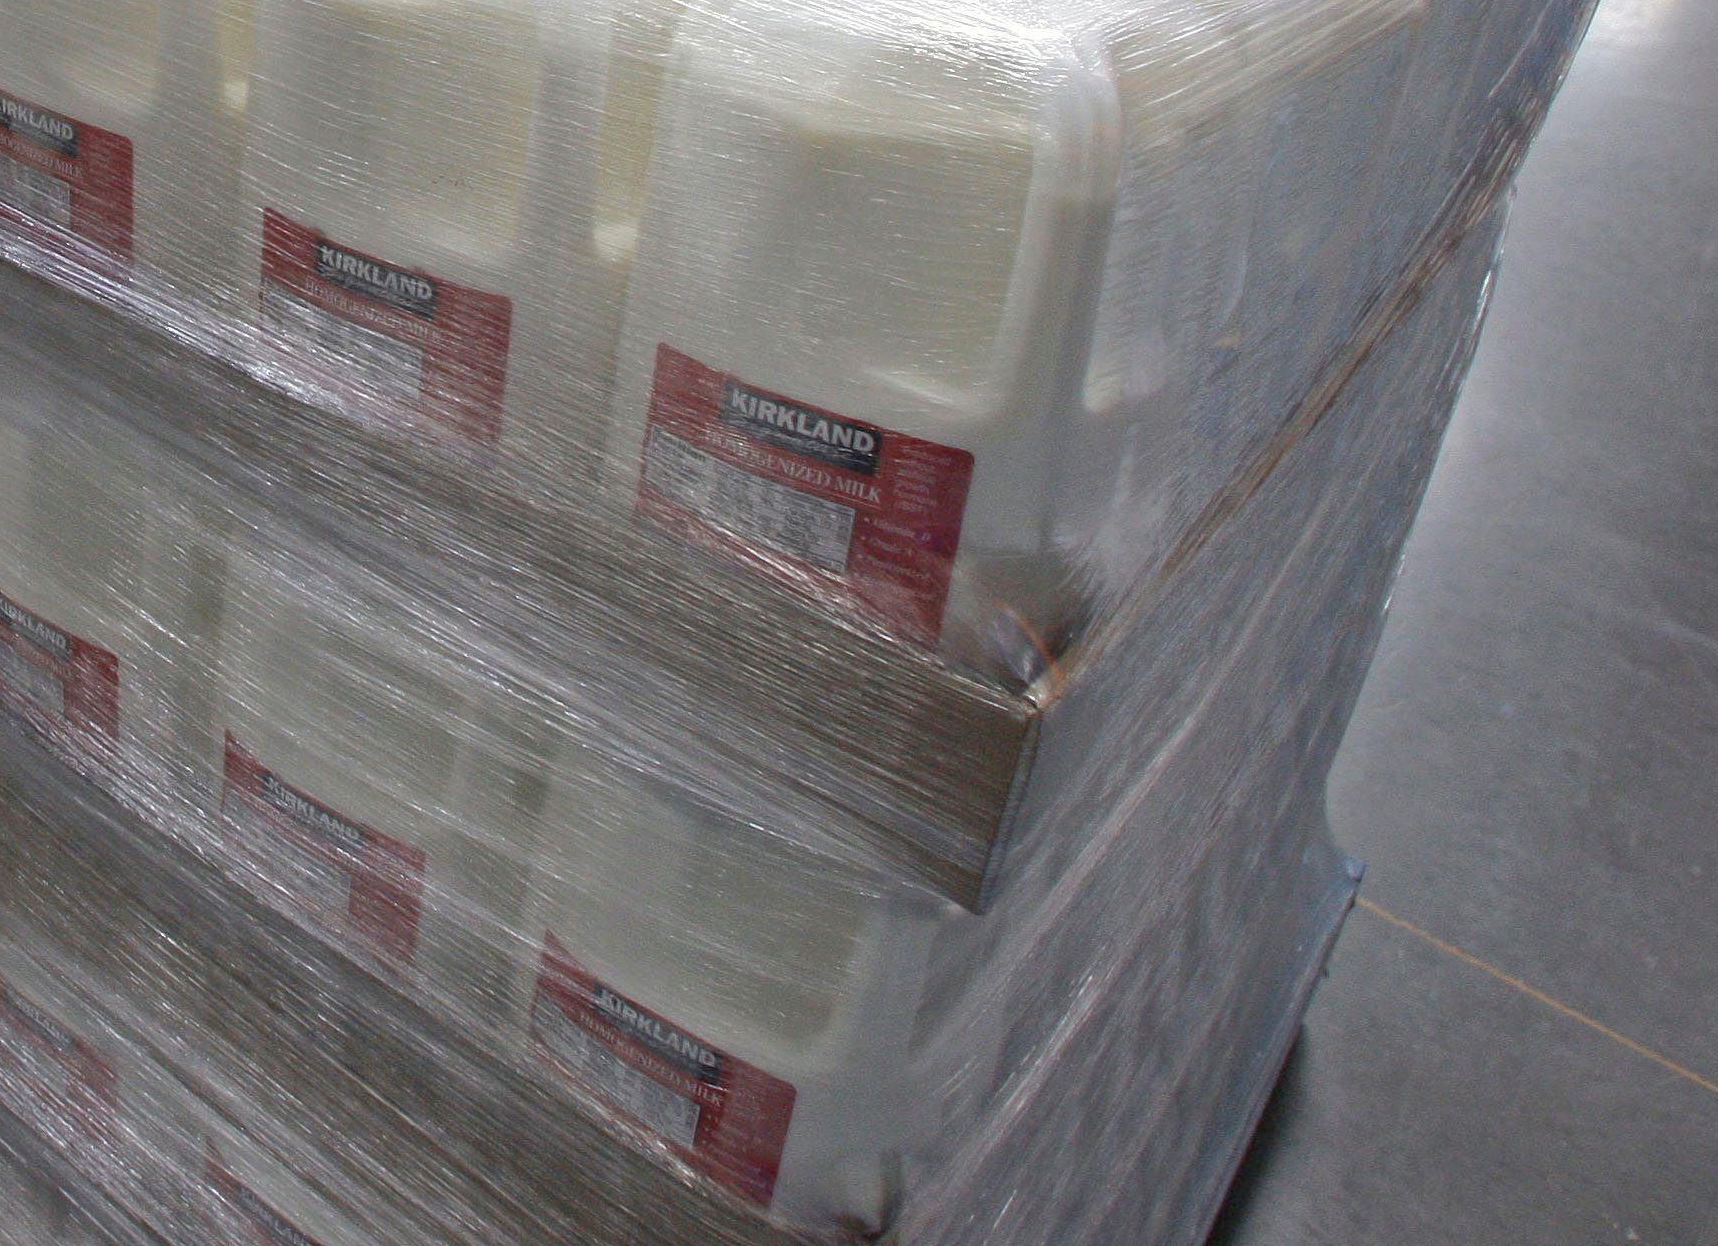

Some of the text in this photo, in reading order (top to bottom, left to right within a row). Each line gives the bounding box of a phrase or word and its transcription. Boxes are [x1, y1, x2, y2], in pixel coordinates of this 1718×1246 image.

[319, 244, 434, 301] KIRKLAND
[730, 386, 875, 454] KIRKLAND
[834, 474, 883, 505] MILK
[265, 774, 361, 841] KIRKLAND
[596, 987, 717, 1068] KIRKLAND
[683, 1078, 723, 1107] MILK
